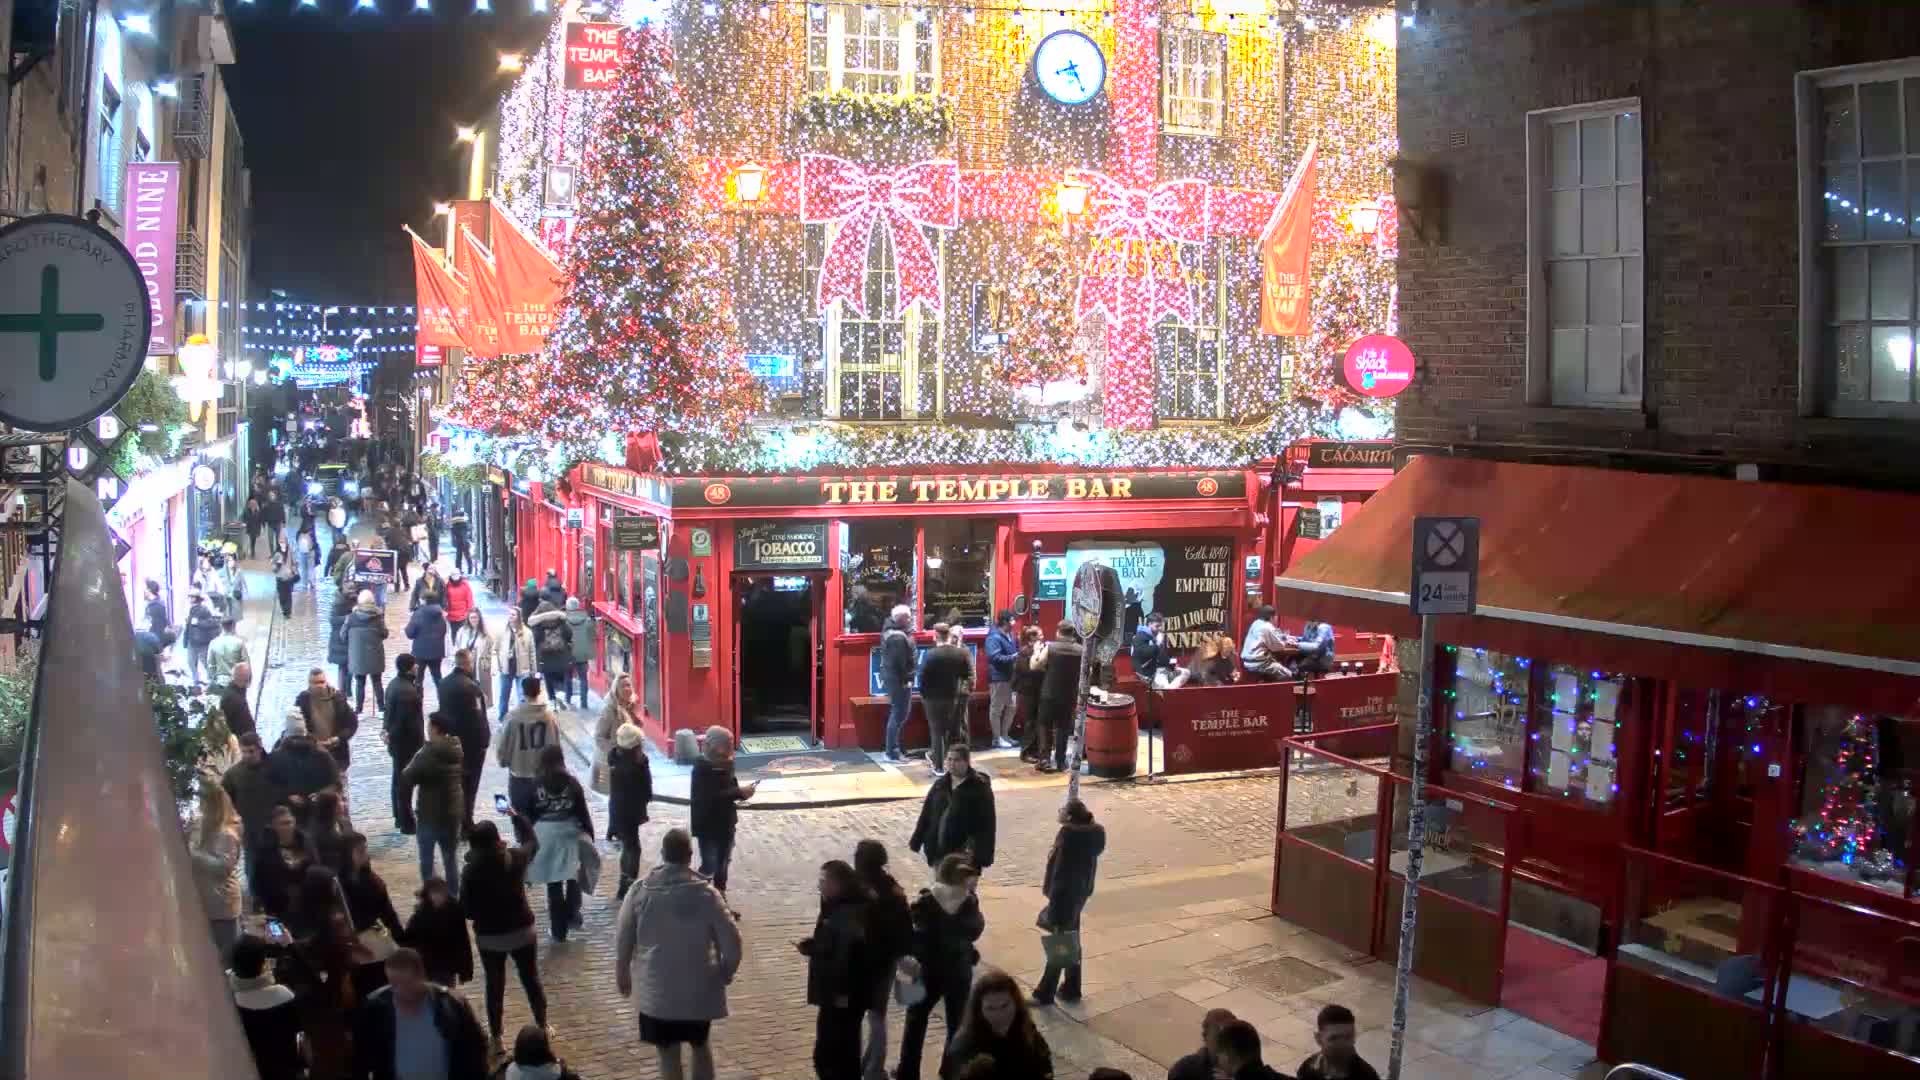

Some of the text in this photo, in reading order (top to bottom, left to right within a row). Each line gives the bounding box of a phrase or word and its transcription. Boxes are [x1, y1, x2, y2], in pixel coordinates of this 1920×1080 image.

[584, 28, 617, 44] THE
[136, 170, 169, 232] NINE
[523, 302, 547, 312] THE
[504, 311, 553, 325] TEMPL
[709, 487, 726, 500] 48
[823, 478, 1132, 504] THE TEMPLE BAR
[1201, 481, 1214, 493] 48
[1122, 545, 1146, 557] THE
[1208, 545, 1229, 560] 1840
[1109, 556, 1157, 568] TEMPLE
[1203, 562, 1226, 577] THE
[1122, 567, 1145, 578] BAR
[1175, 577, 1226, 593] EMPEROR
[1421, 583, 1442, 602] 24
[1211, 592, 1225, 607] OF
[1221, 710, 1240, 718] THE
[1192, 715, 1269, 731] TEMPLE BAR
[519, 721, 546, 750] 10
